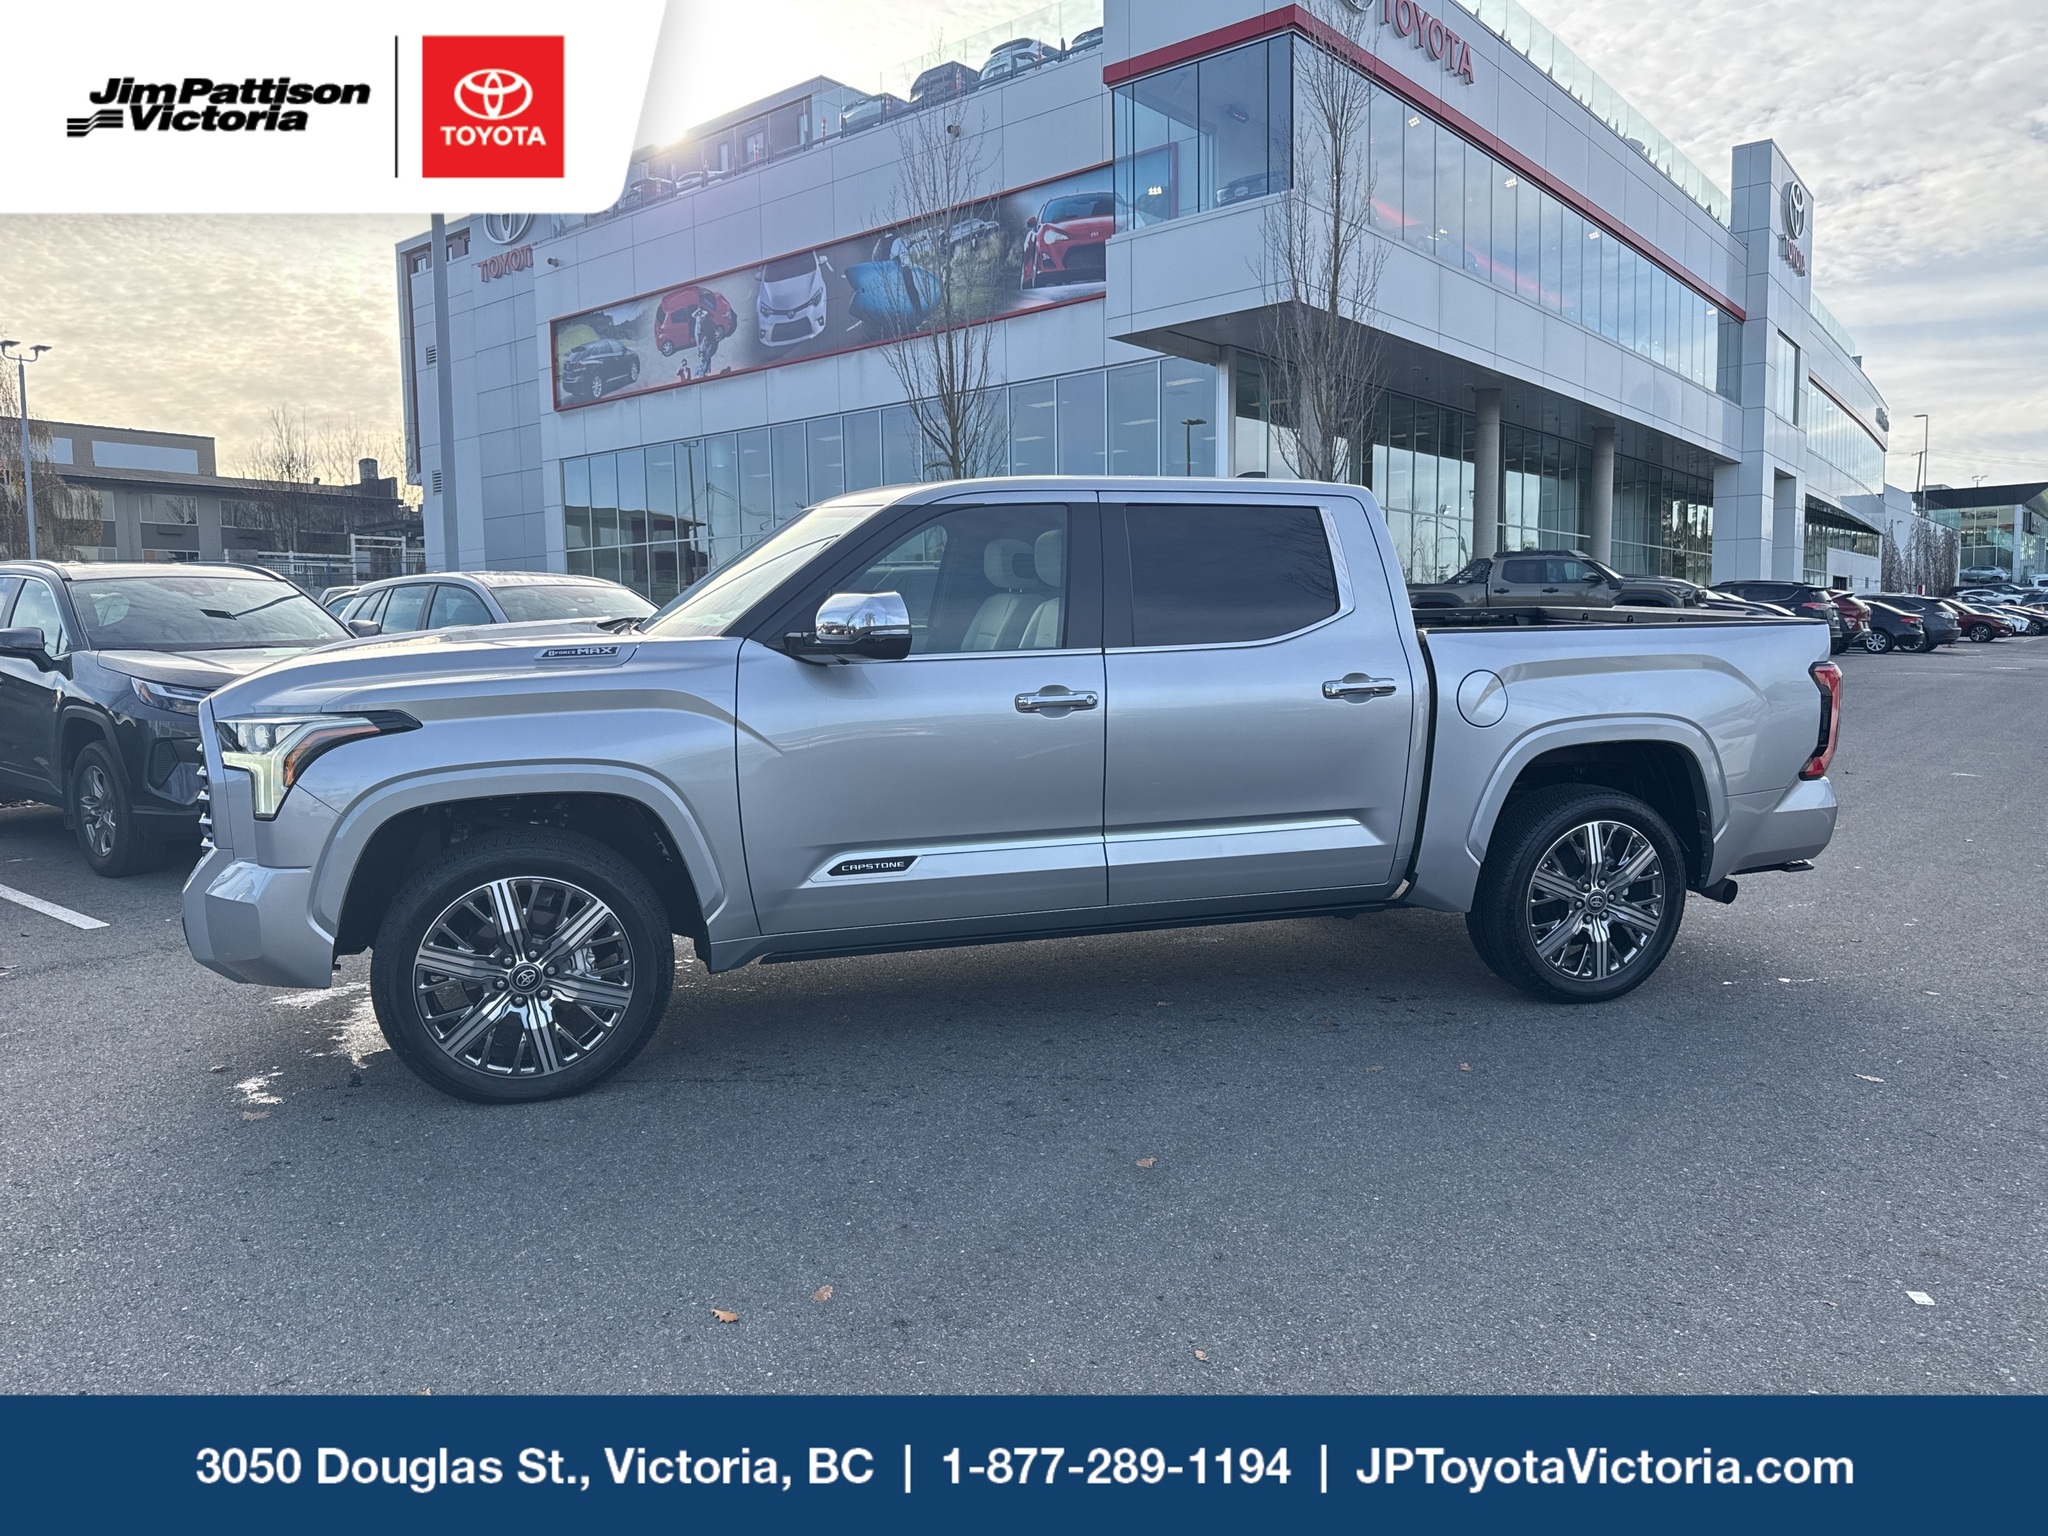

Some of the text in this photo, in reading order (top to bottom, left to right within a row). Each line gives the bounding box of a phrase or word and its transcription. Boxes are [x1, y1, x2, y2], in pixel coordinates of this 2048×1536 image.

[478, 244, 534, 283] TOYOT
[577, 647, 613, 655] MAX
[841, 861, 905, 872] CAPSTONE
